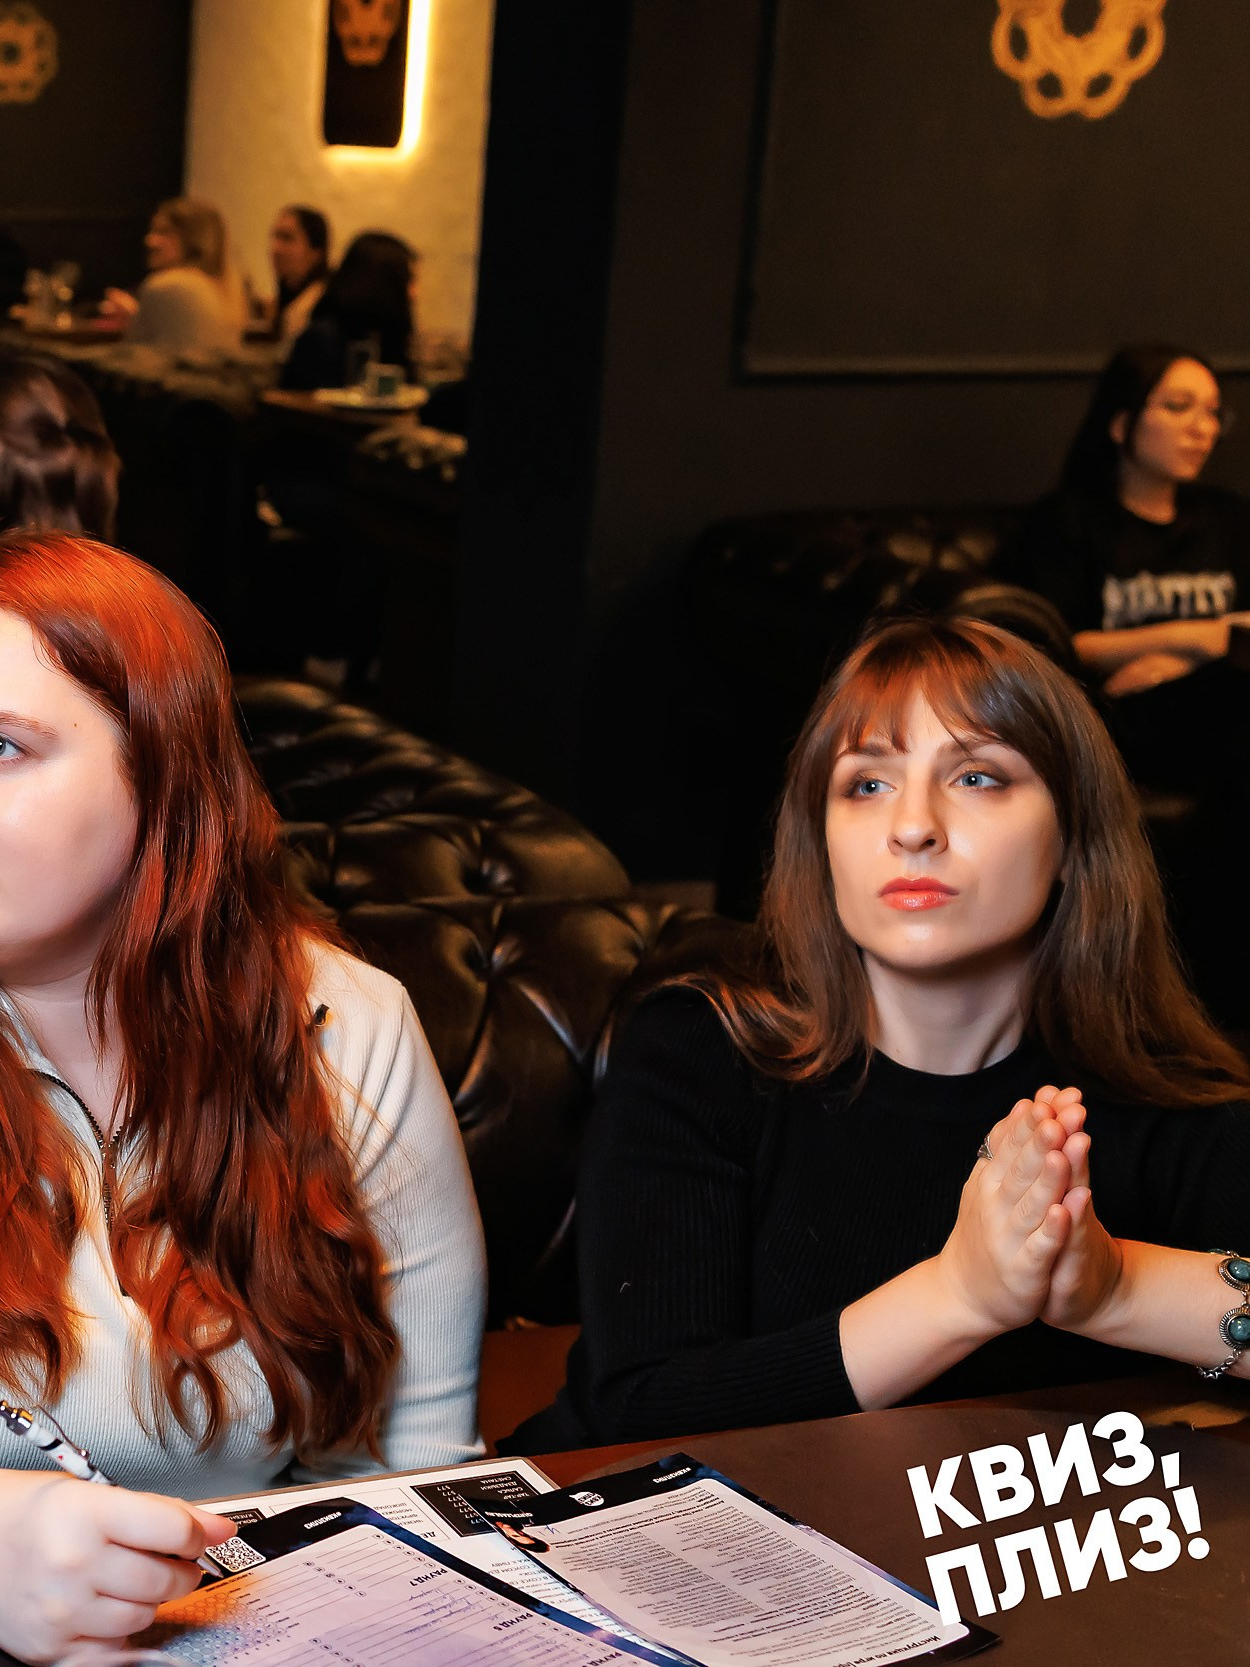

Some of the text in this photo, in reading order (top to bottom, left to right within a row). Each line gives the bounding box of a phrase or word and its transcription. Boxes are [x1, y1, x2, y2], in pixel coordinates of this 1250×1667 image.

[415, 1568, 448, 1584] РАУНД
[500, 1612, 534, 1629] РАУНД
[886, 1635, 941, 1657] Инструкция
